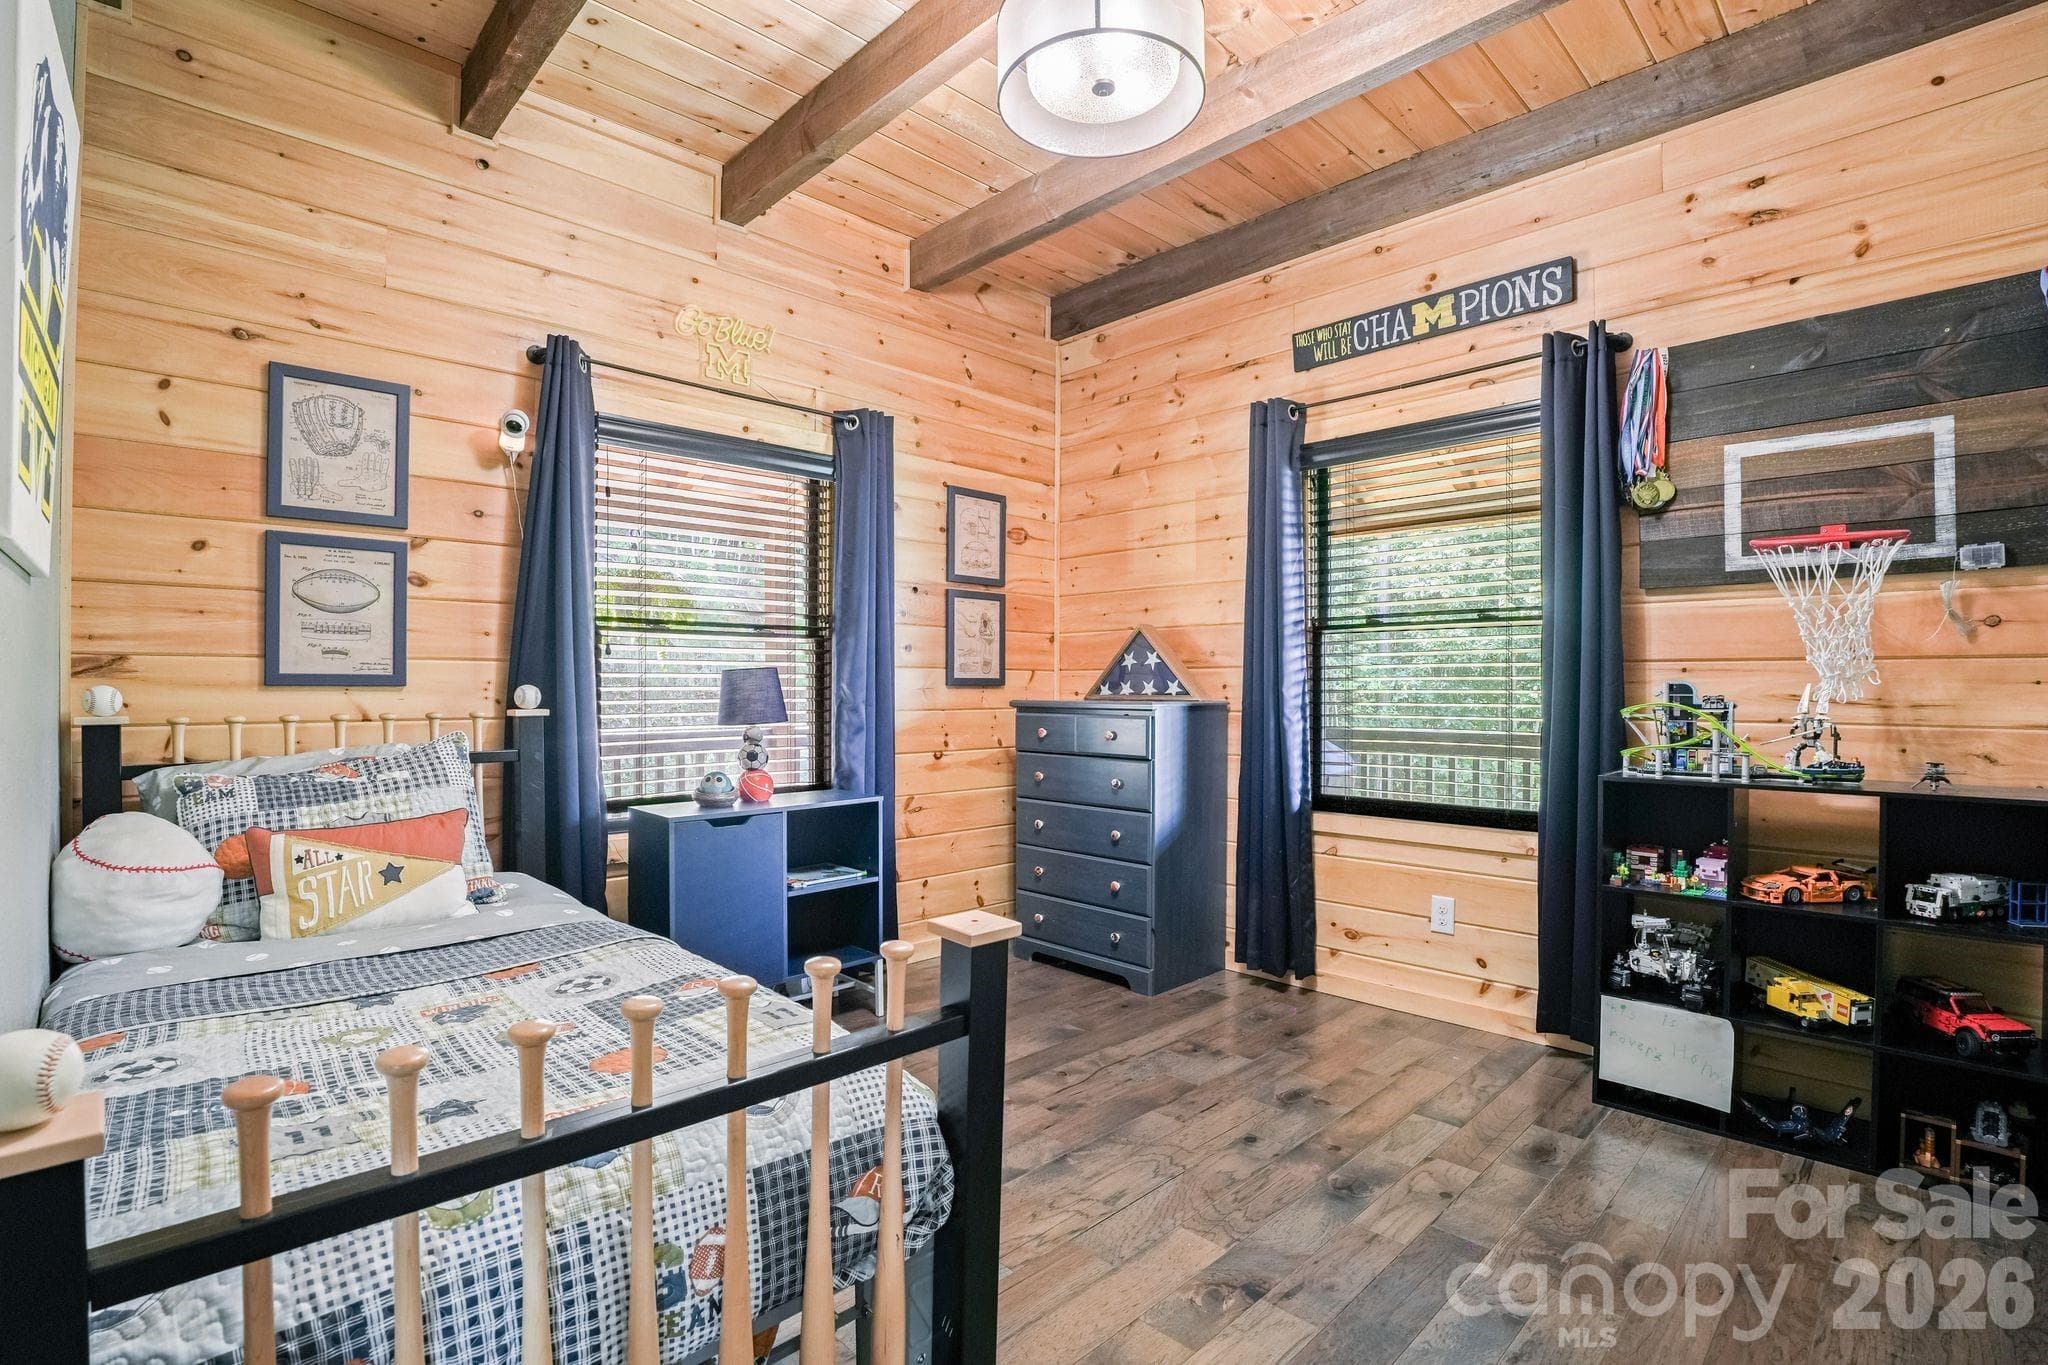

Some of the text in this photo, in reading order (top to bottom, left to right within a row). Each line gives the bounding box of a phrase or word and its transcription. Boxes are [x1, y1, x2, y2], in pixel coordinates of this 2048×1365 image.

[675, 304, 777, 354] Go Blue!
[1353, 266, 1563, 351] CHAMPIONS
[1294, 320, 1352, 348] THOSE WHO STAY
[1313, 336, 1352, 362] WILL BE
[705, 343, 751, 386] M
[303, 849, 336, 870] ALL
[298, 860, 375, 930] STAR
